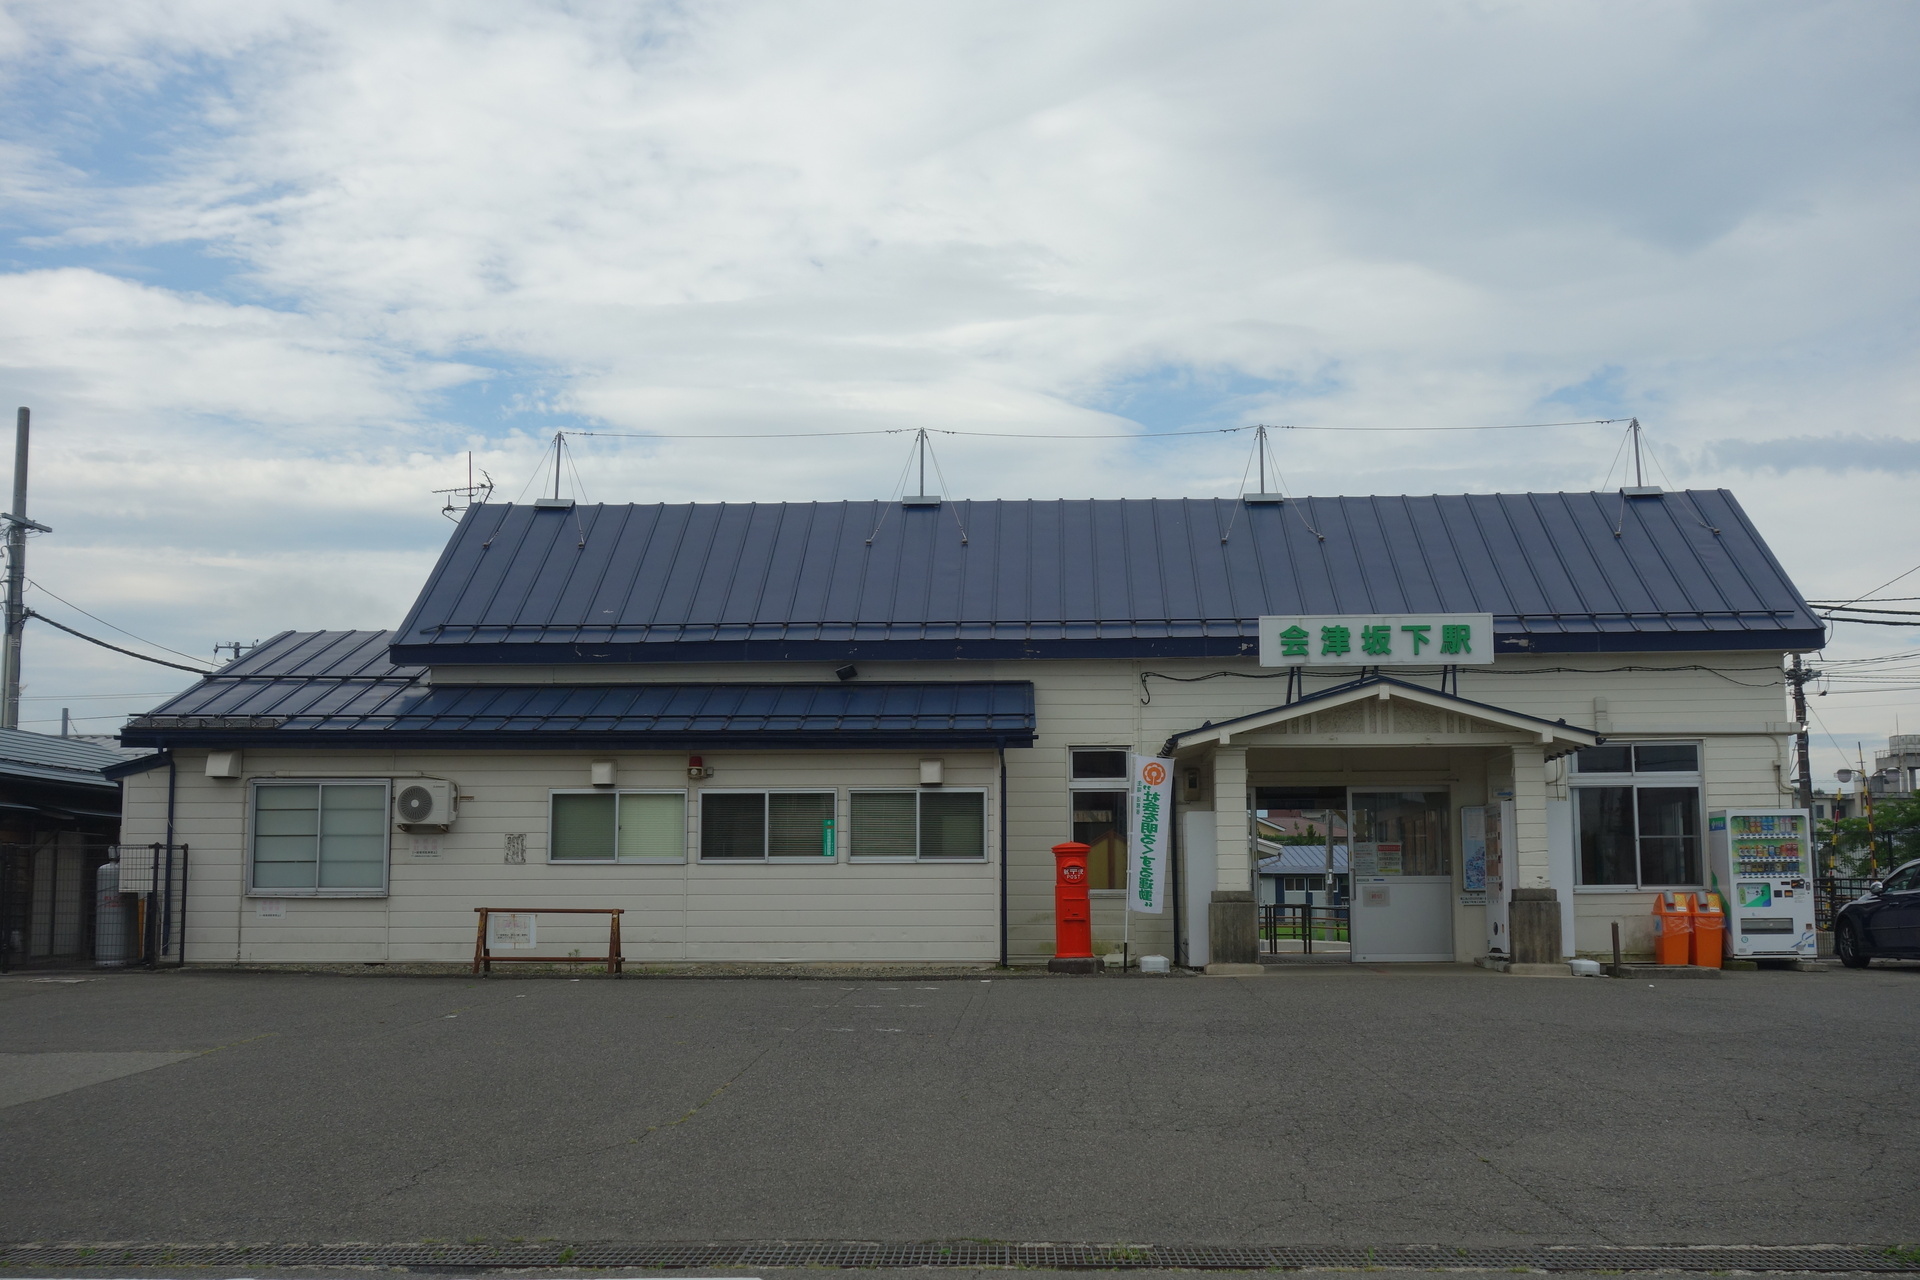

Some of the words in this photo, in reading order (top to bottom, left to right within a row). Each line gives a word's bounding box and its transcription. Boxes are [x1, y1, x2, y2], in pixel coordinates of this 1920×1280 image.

[1280, 625, 1472, 656] 会津坂下駅
